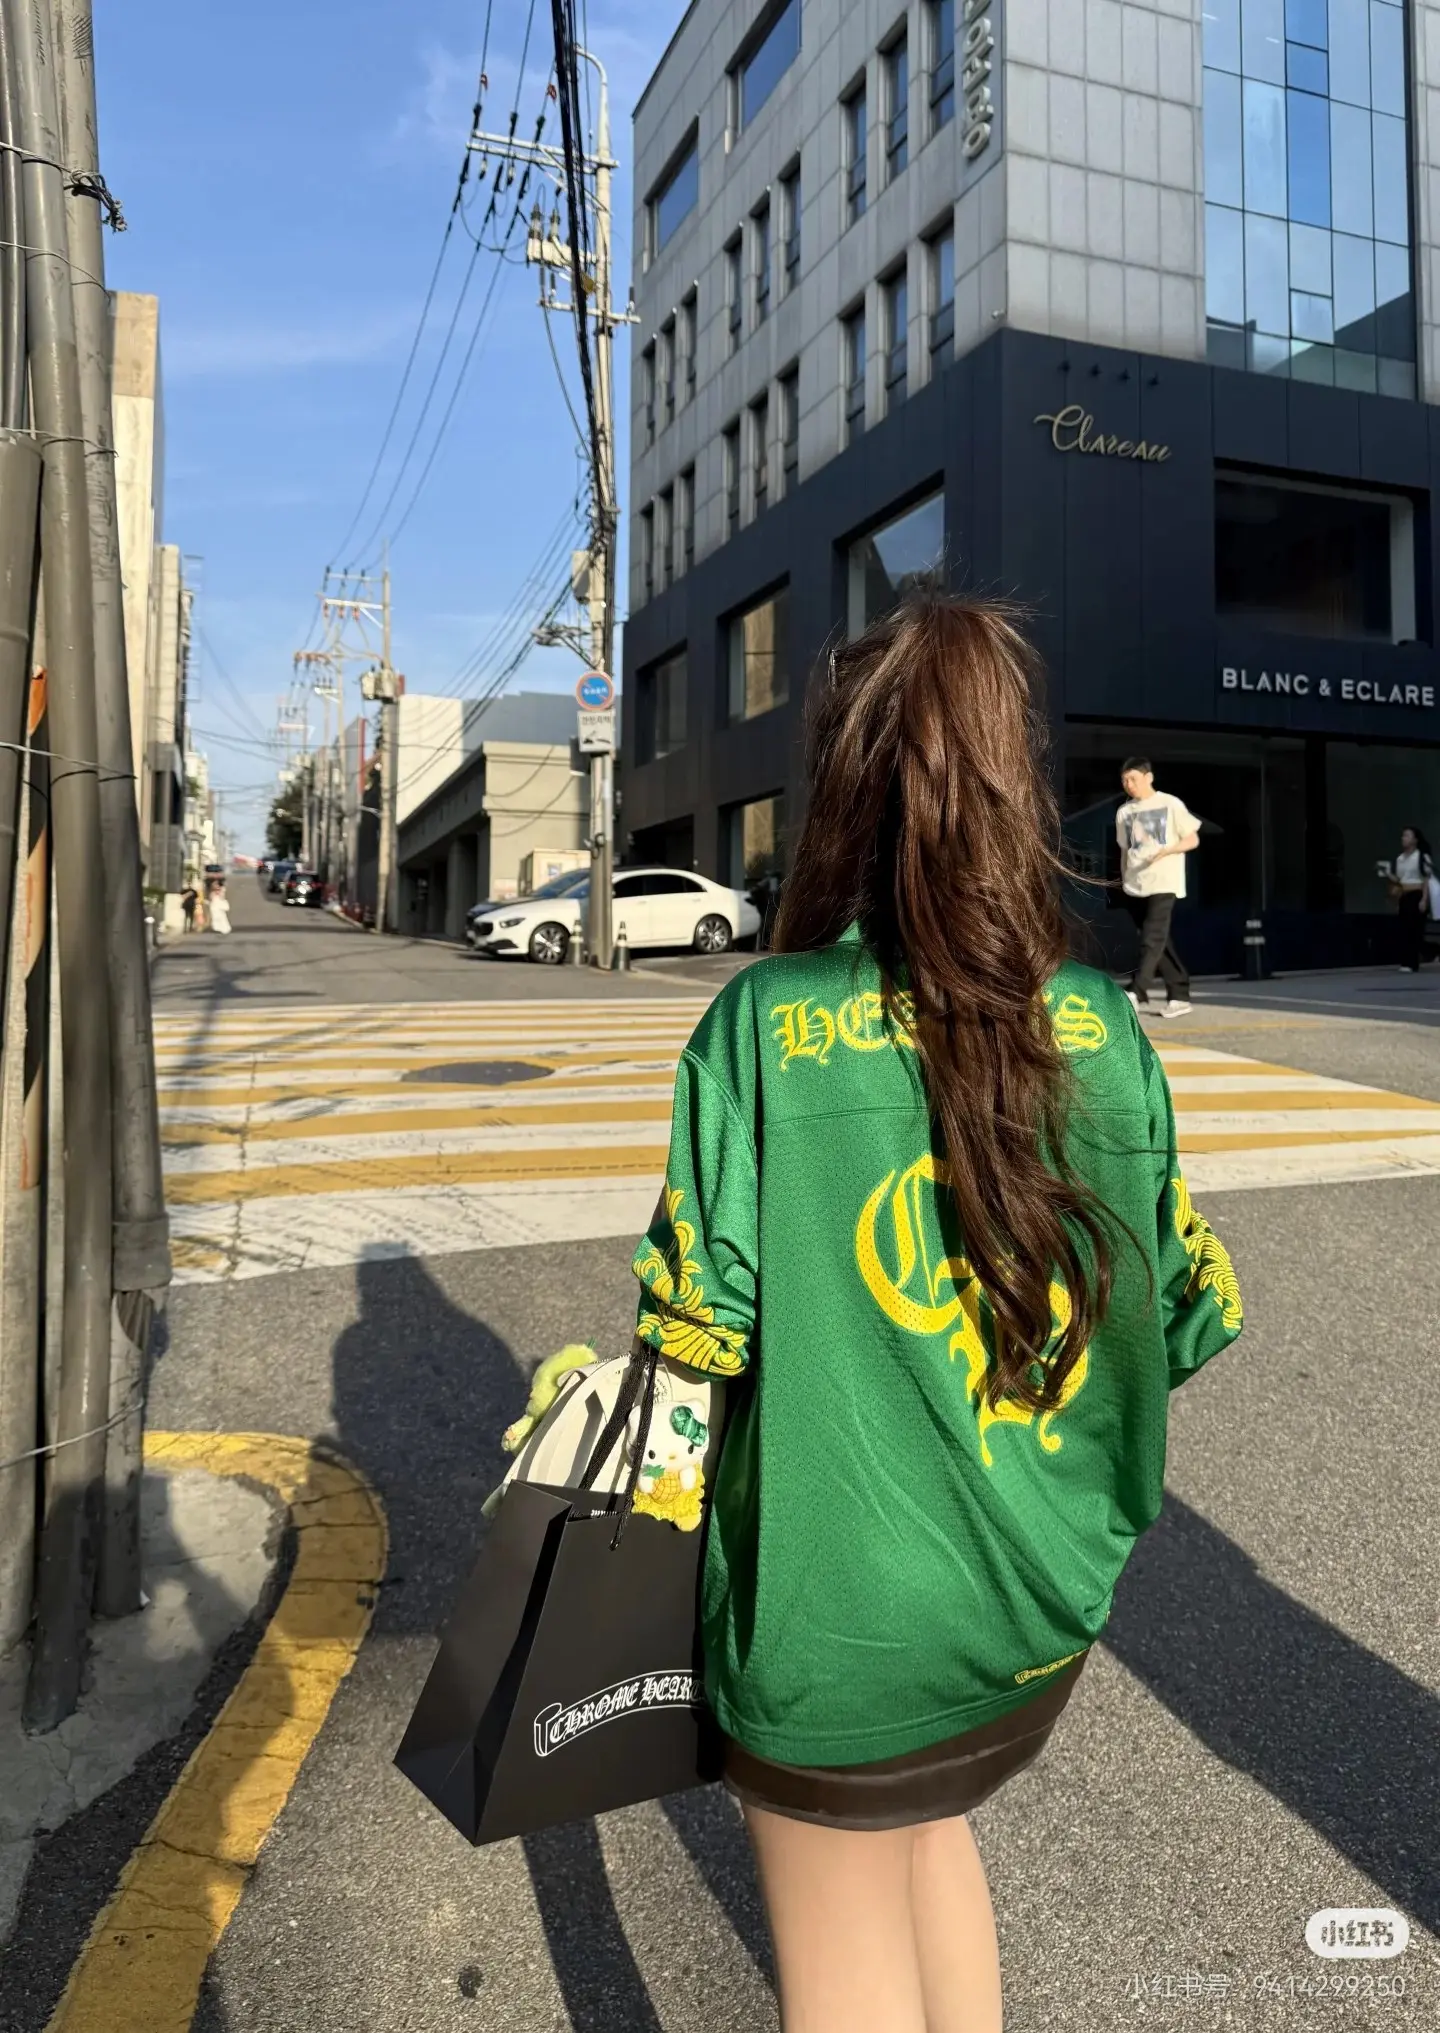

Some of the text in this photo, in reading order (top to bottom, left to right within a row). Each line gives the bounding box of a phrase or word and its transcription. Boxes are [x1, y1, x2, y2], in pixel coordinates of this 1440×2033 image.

[1222, 667, 1435, 707] BLANC & ECLARE
[549, 1681, 640, 1744] CHROME
